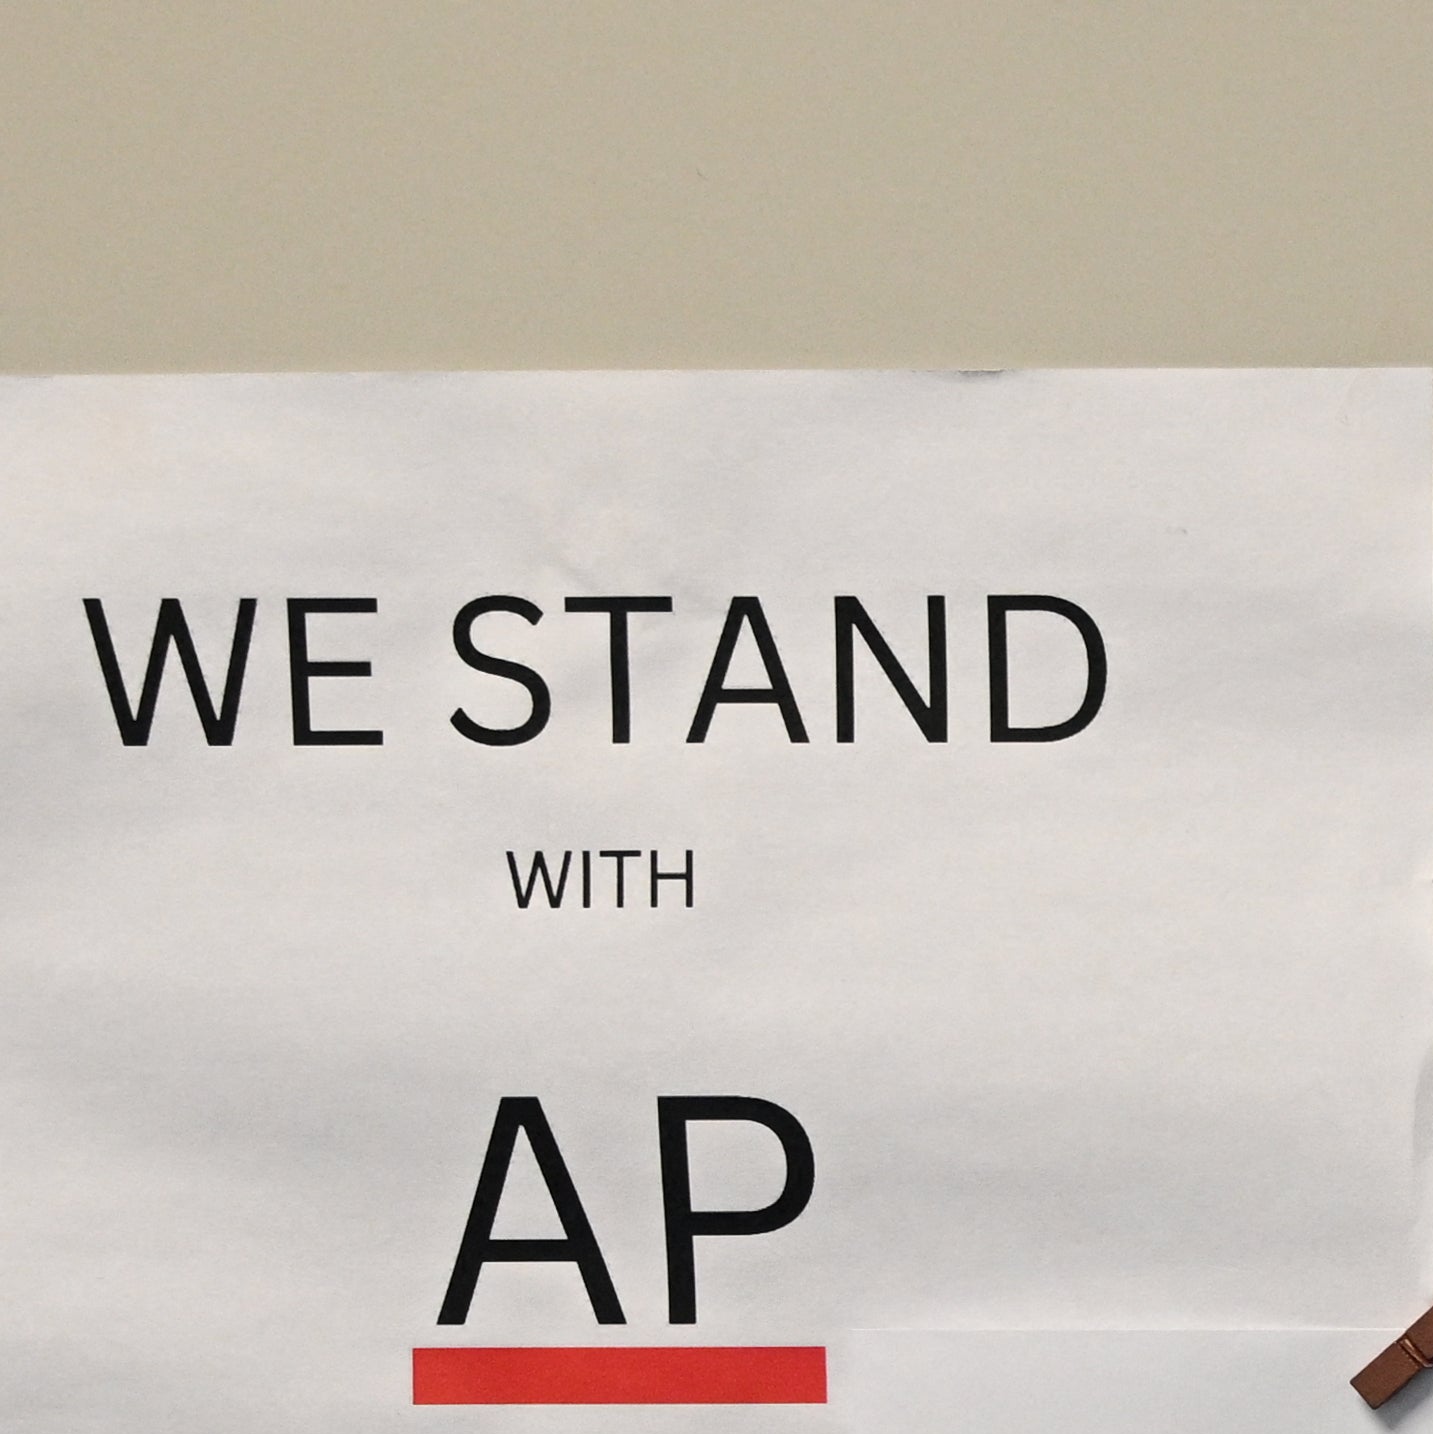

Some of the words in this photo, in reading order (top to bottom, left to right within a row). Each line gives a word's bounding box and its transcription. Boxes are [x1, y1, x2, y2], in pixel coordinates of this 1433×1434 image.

[81, 596, 385, 748] WE
[448, 593, 1109, 748] STAND
[505, 848, 694, 910] WITH
[435, 1094, 816, 1327] AP
